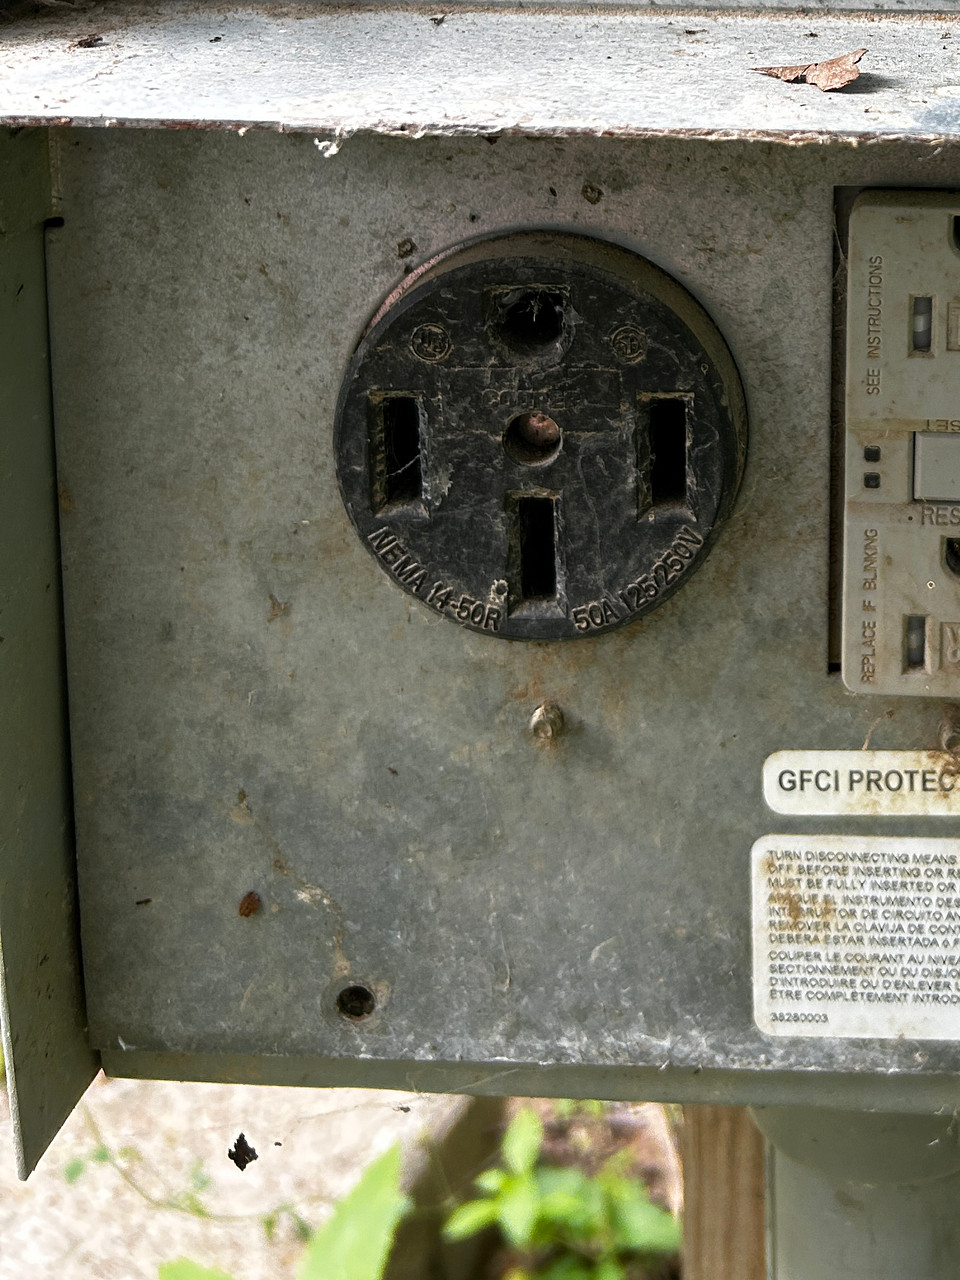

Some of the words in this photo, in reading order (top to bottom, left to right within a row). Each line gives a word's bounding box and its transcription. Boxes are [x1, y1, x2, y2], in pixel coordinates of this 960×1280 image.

[867, 255, 883, 359] INSTRUCTIONS
[867, 368, 881, 396] SEE
[367, 525, 431, 593] NEMA
[429, 579, 504, 632] 14-50R
[572, 594, 618, 633] 50A
[618, 524, 704, 613] 125/250V
[864, 528, 878, 591] BLINKING
[863, 598, 877, 612] IF
[861, 621, 877, 683] REPLACE
[779, 770, 839, 791] GFCI
